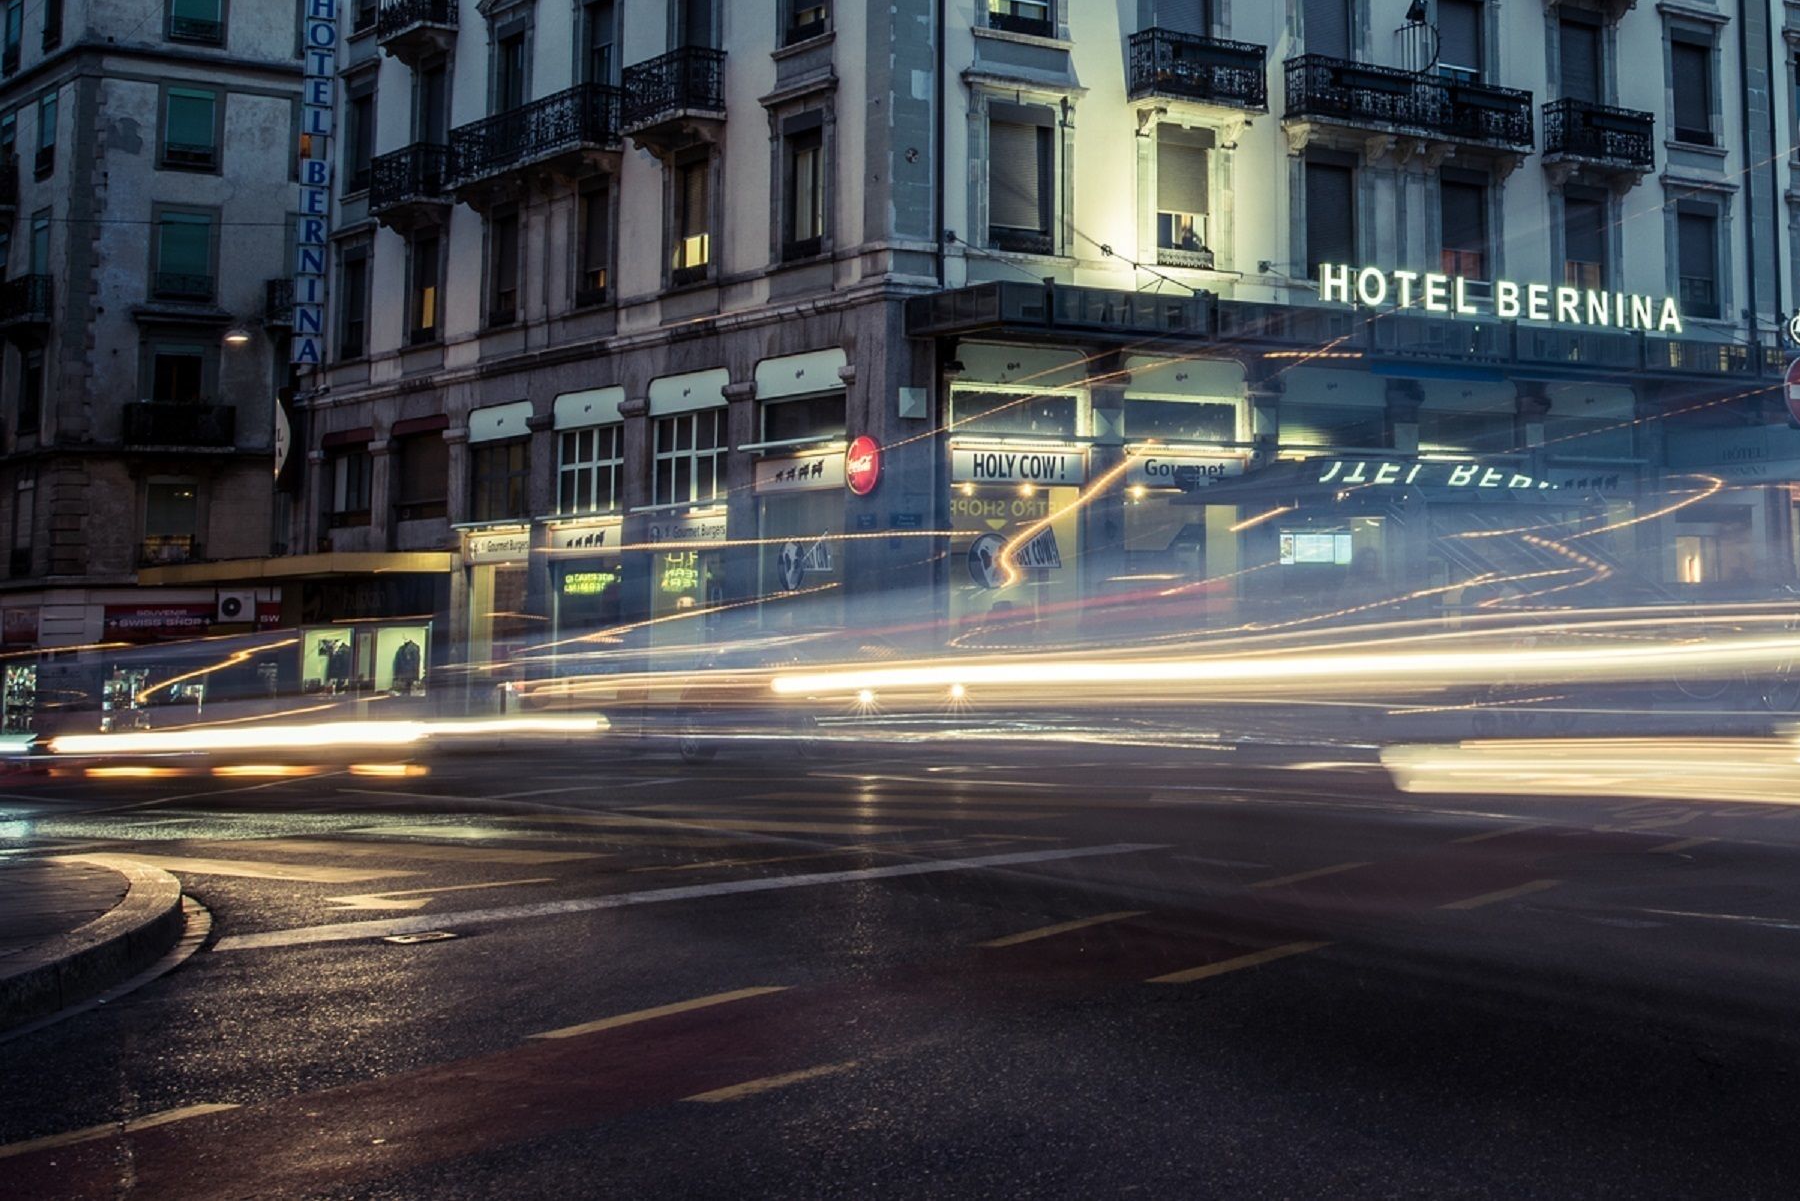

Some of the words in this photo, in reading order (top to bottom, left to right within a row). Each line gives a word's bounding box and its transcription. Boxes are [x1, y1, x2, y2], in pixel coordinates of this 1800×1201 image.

[297, 160, 328, 363] BERNINA
[1319, 263, 1477, 315] HOTEL
[1496, 280, 1683, 334] BERNINA
[973, 453, 1016, 479] HOLY
[1019, 455, 1056, 480] COW
[1144, 458, 1226, 479] Goumet
[119, 619, 162, 628] SWISS
[166, 617, 203, 627] SHOP
[136, 609, 188, 617] SOUVENIR
